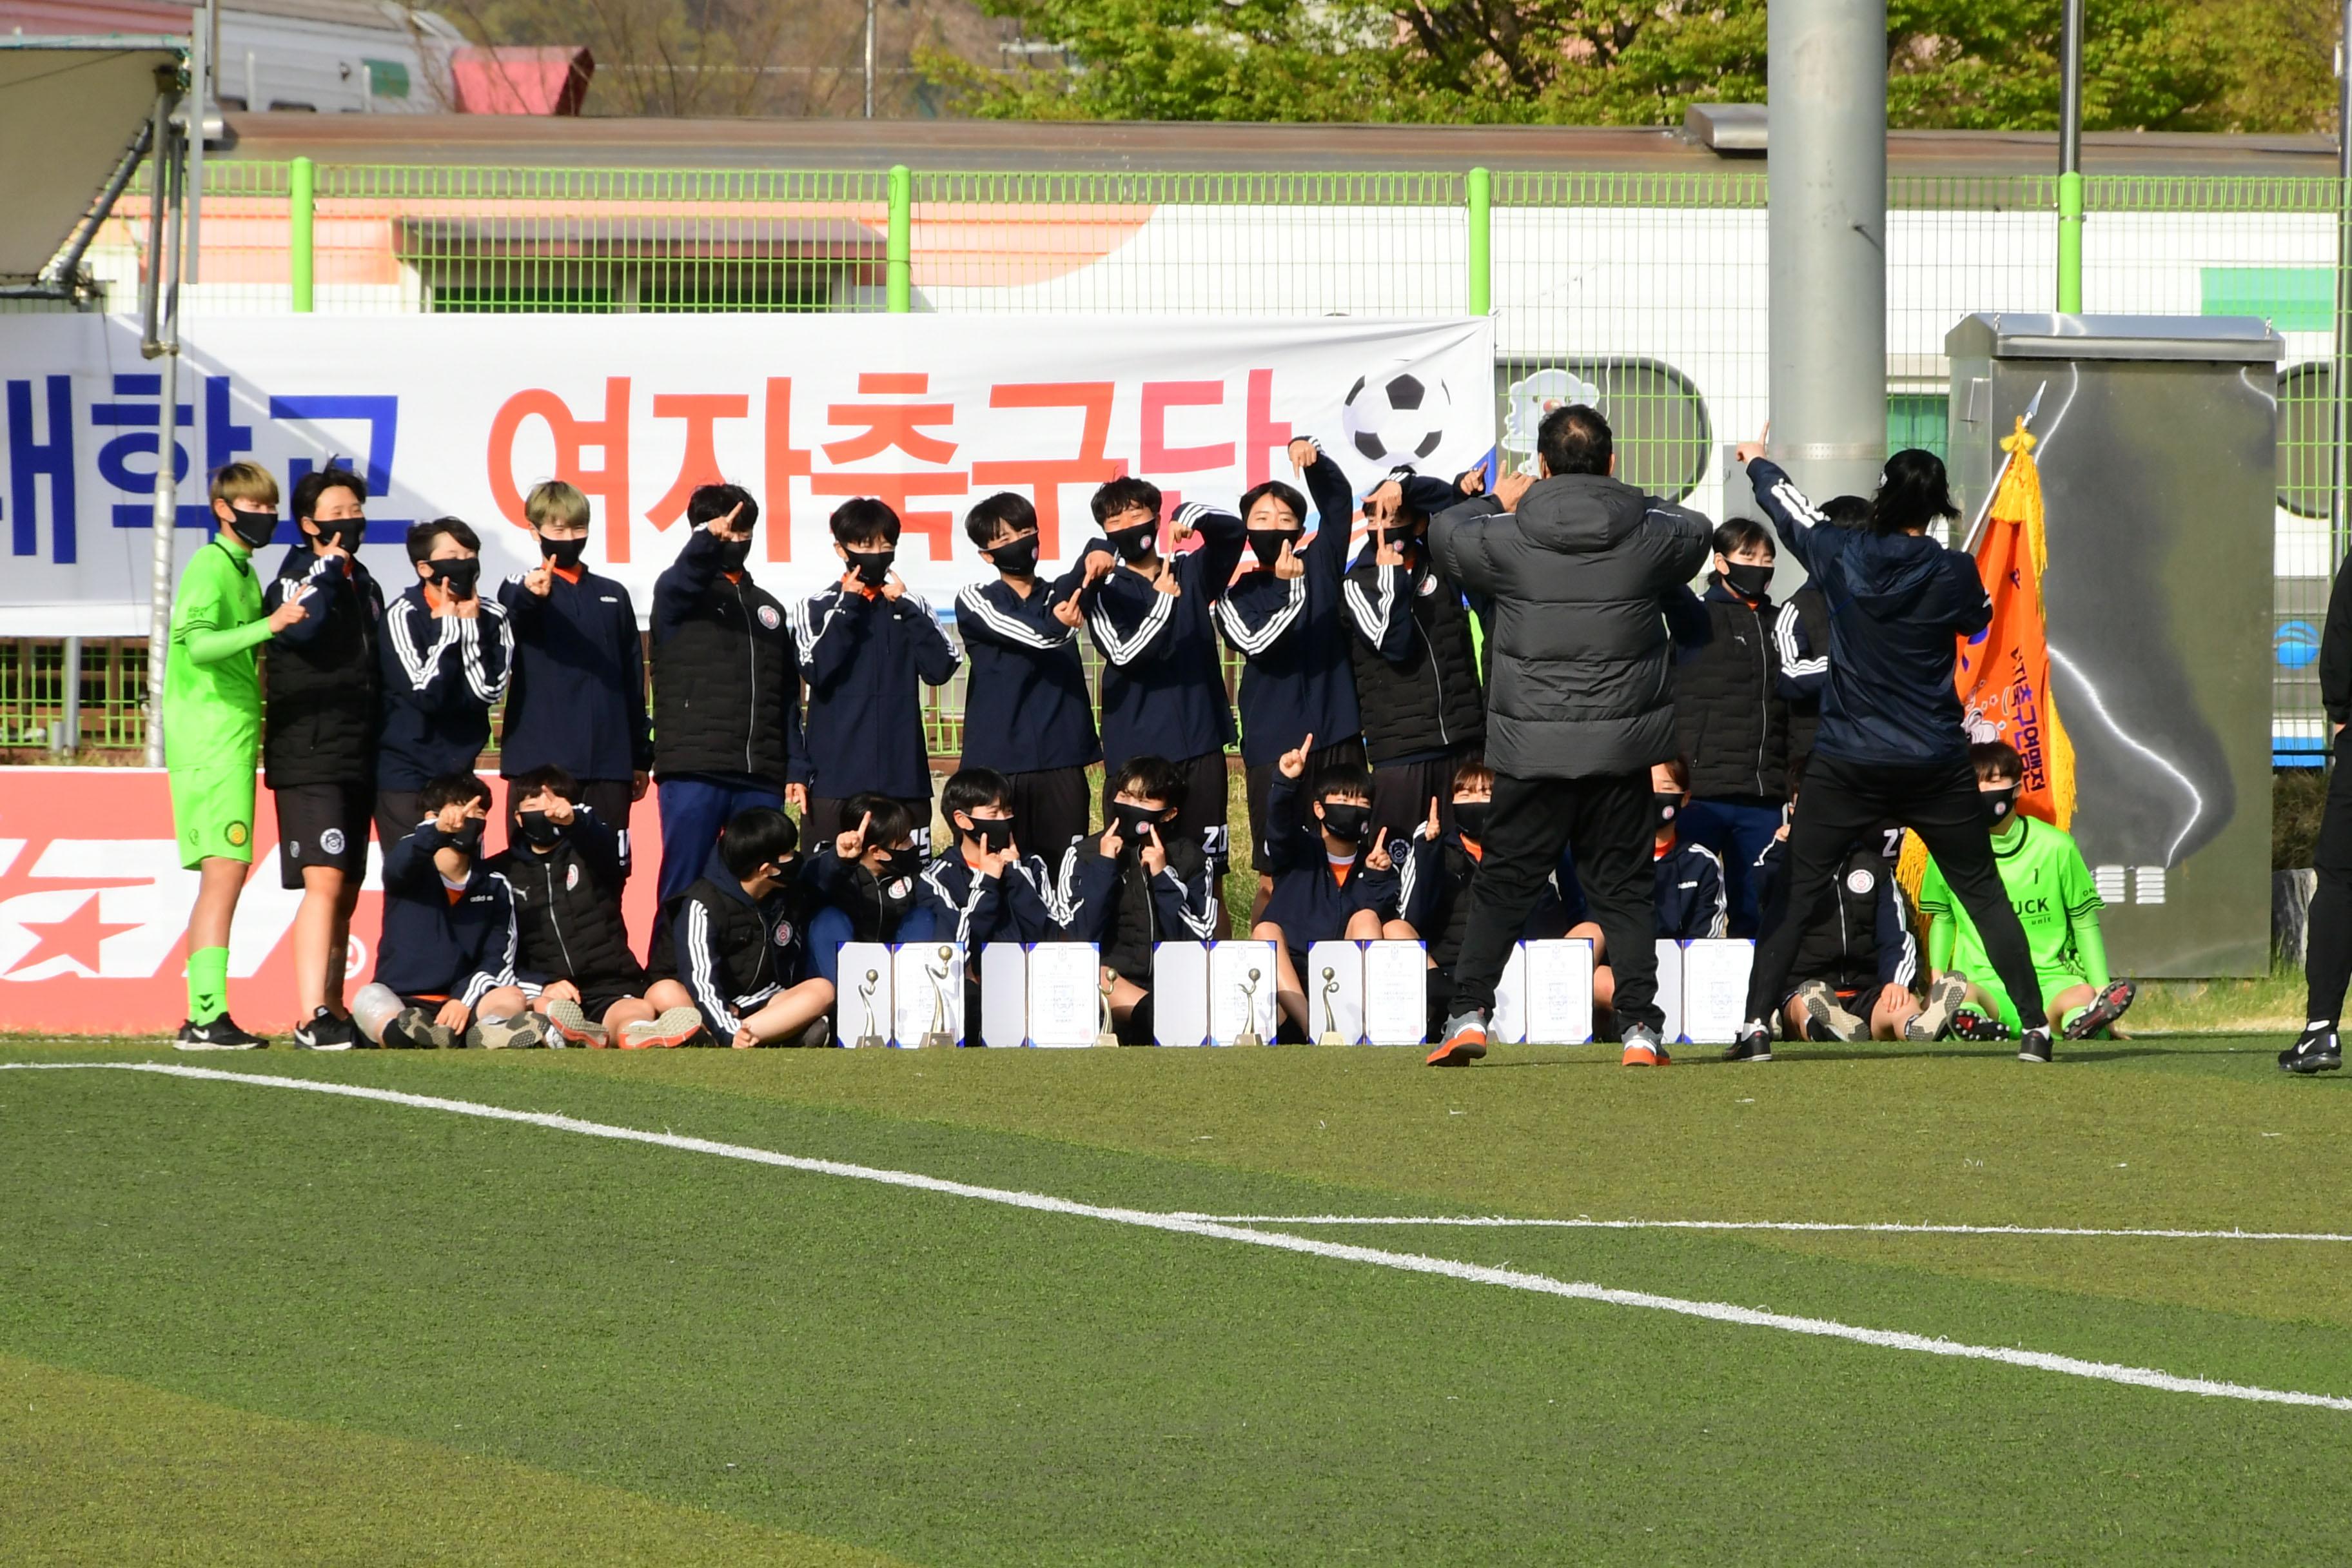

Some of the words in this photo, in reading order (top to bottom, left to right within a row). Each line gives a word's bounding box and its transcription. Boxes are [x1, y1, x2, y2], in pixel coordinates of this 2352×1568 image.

[0, 374, 415, 565] 학교
[487, 368, 1292, 565] 여자축구단
[2011, 897, 2050, 915] UCK
